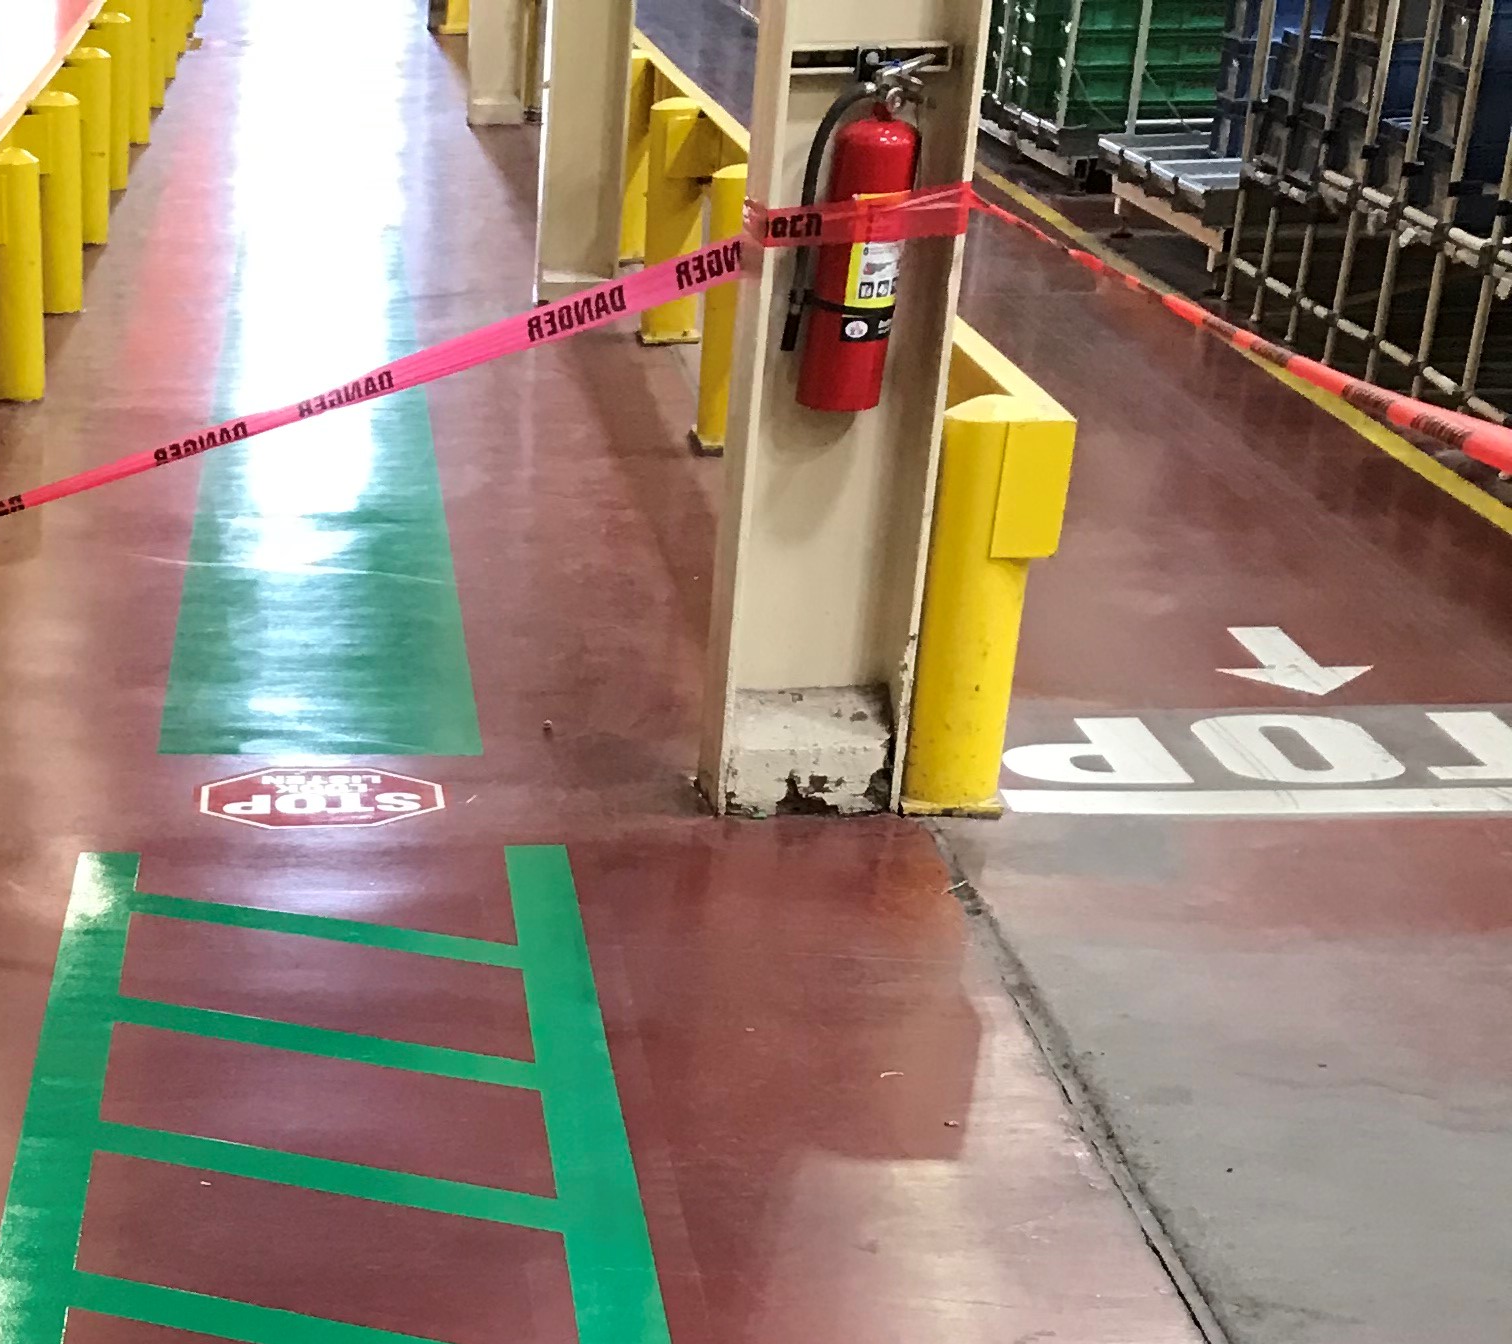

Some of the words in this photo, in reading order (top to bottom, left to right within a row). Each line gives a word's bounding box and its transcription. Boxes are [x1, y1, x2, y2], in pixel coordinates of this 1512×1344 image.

[261, 775, 381, 785] LISTEN
[276, 784, 367, 793] LOOK
[222, 792, 422, 814] STOP
